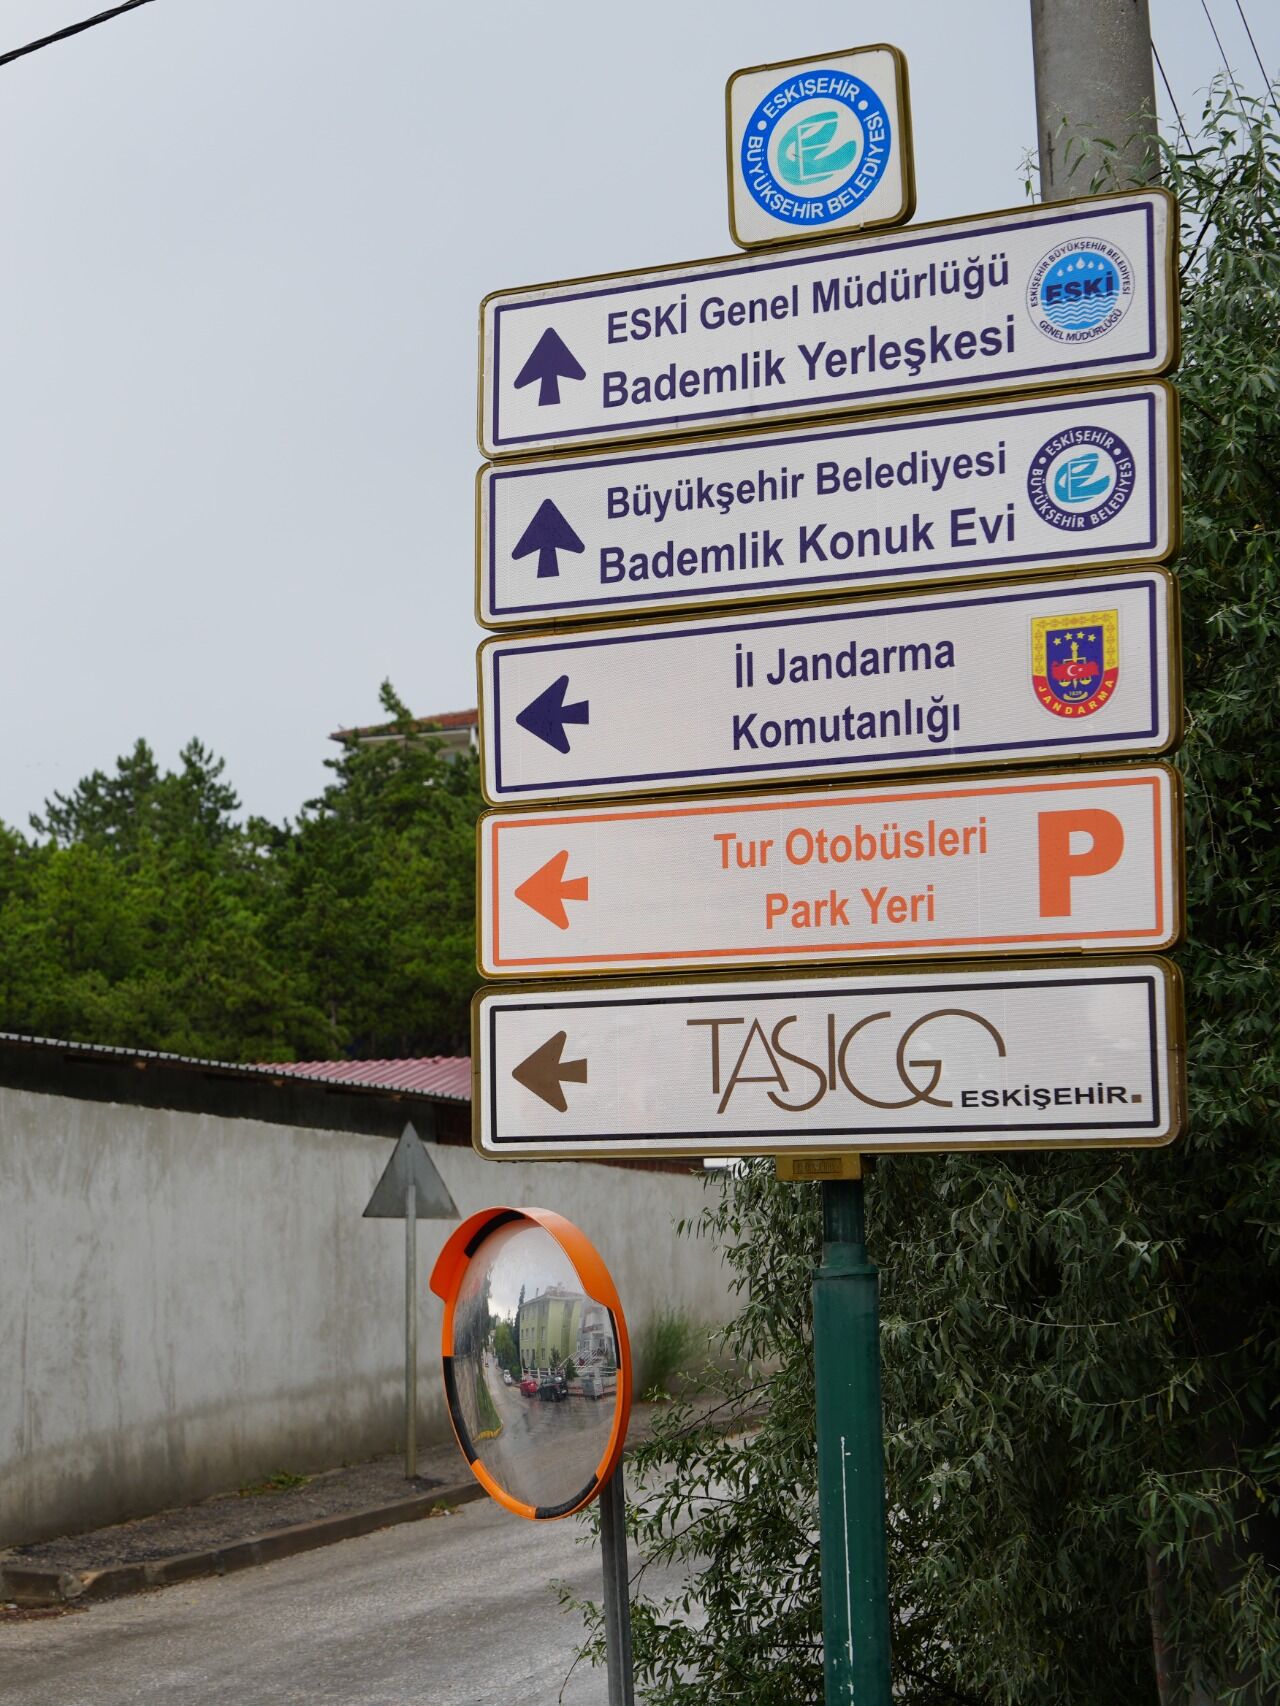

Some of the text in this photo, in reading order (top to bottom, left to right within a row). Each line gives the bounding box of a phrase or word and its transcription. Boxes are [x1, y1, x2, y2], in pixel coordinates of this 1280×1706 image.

[762, 77, 860, 119] ESKİŞEHİR
[746, 110, 885, 219] BÜYÜKŞEHİR BELEDİYESİ
[606, 253, 1010, 345] ESKİ Genel Müdürlüğü
[1030, 261, 1050, 308] ESKİŞEHİR
[1048, 241, 1107, 262] BÜYÜKŞEHİR
[1045, 271, 1114, 305] ESKİ
[1039, 308, 1123, 342] GENEL MÜDÜRLÜĞÜ
[602, 314, 1016, 409] Bademlik Yerleşkesi
[1045, 430, 1114, 456] ESKİŞEHİR
[606, 440, 1007, 522] Büyükşehir Belediyesi
[1030, 457, 1132, 528] BÜYÜKŞEHİR BELEDİYESİ
[600, 503, 1016, 584] Bademlik Konuk Evi
[735, 640, 956, 689] İl Jandarma
[732, 695, 961, 751] Komutanlığı
[1038, 680, 1114, 715] JANDARMA
[713, 816, 987, 870] Tur Otobüsleri
[1037, 808, 1125, 918] P
[765, 884, 935, 930] Park Yeri
